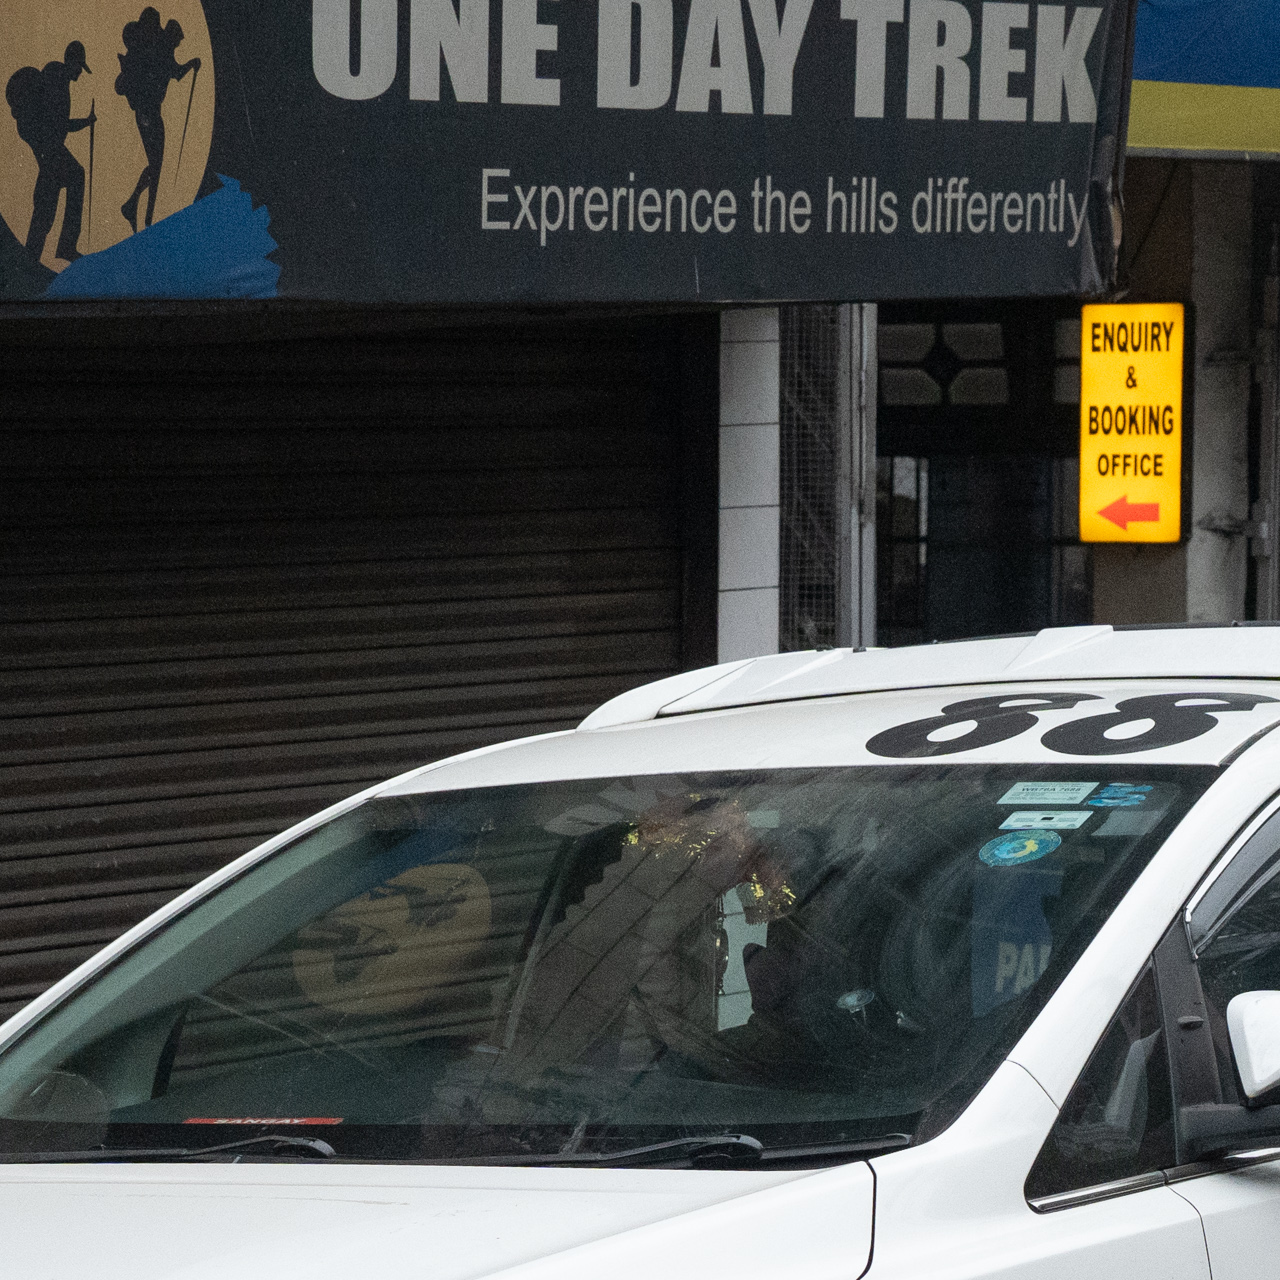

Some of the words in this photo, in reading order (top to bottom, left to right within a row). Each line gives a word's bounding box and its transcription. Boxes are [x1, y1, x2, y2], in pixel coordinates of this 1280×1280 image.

[597, 0, 809, 116] DAY
[840, 1, 1104, 122] TREK
[480, 168, 738, 247] Exprerience
[751, 176, 812, 233] the
[826, 177, 899, 233] hills
[911, 177, 1088, 247] differently
[1091, 321, 1174, 353] ENQUIRY
[1125, 366, 1137, 389] &
[1089, 405, 1174, 435] BOOKING
[1097, 454, 1163, 476] OFFICE
